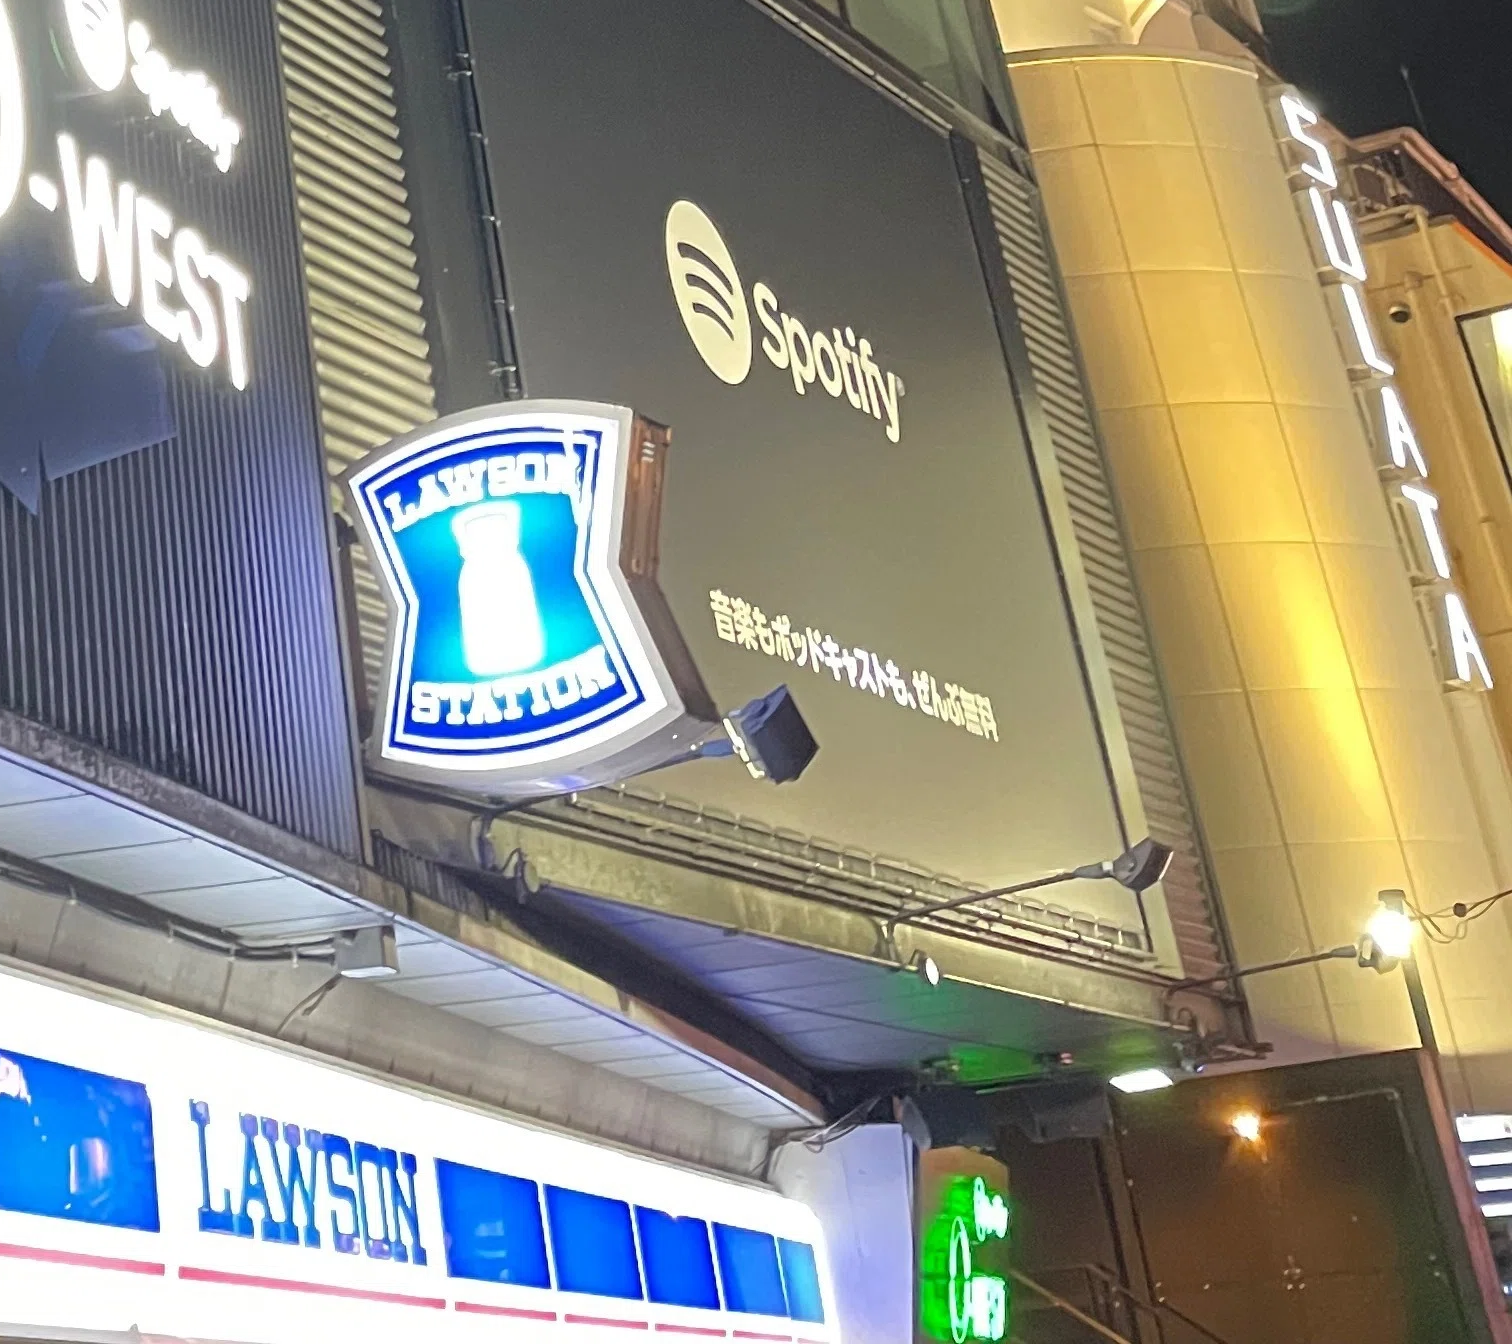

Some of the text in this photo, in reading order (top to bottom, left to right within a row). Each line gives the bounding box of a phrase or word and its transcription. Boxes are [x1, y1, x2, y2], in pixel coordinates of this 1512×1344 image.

[752, 280, 901, 443] Spotify
[1280, 93, 1494, 690] SULATA
[383, 452, 580, 533] LAWSON
[411, 643, 617, 725] STATION
[188, 1098, 428, 1267] LAWSON
